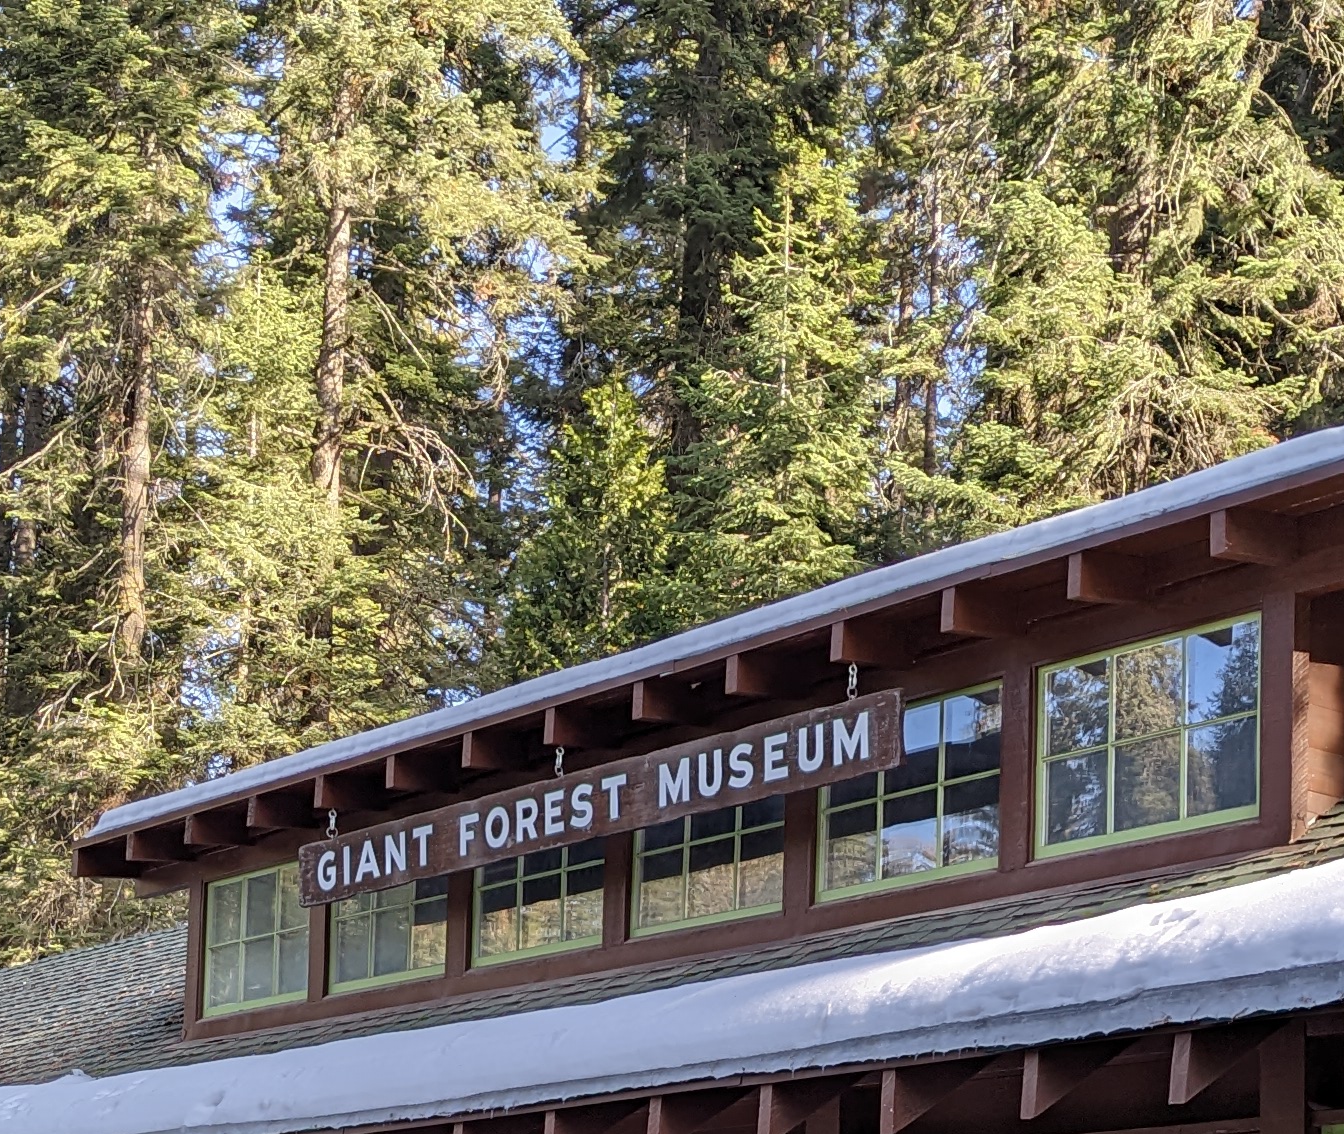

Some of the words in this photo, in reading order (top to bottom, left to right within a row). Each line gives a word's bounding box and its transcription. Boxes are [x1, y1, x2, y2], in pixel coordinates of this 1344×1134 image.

[317, 824, 434, 891] GIANT
[459, 773, 628, 857] FOREST
[658, 711, 871, 807] MUSEUM
